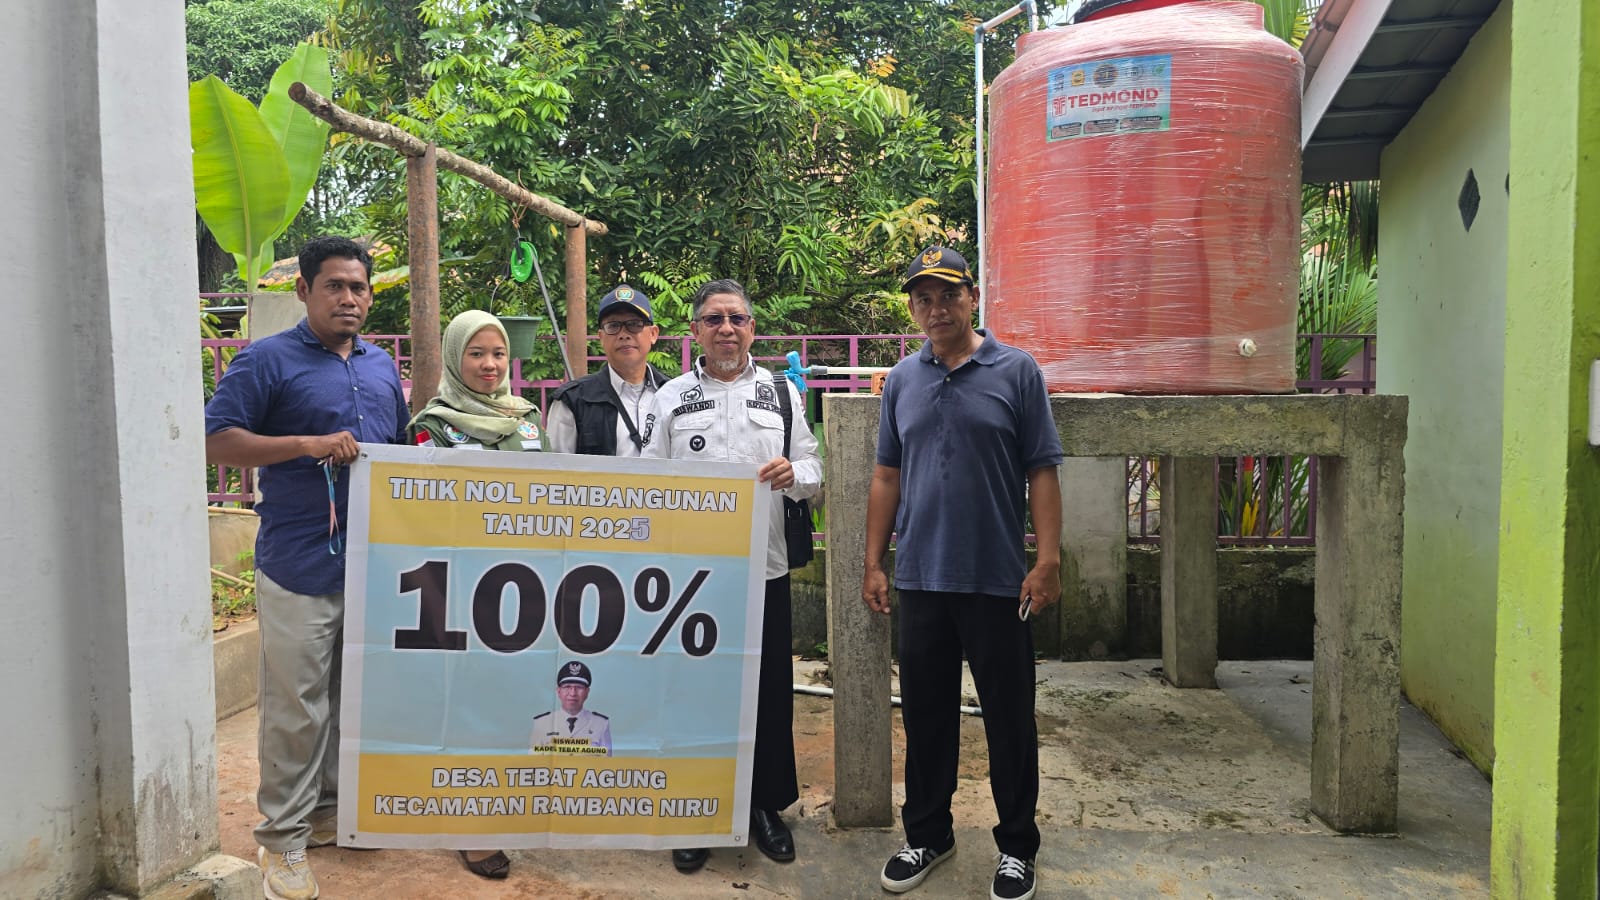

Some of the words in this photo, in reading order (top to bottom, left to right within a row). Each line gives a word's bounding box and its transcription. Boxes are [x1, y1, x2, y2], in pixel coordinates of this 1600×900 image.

[1068, 88, 1159, 108] TEDMOND
[389, 477, 457, 501] TITIK
[465, 480, 523, 504] NOL
[529, 483, 737, 512] PEMBANGUNAN
[483, 513, 573, 537] TAHUN
[580, 517, 650, 541] 2025
[393, 559, 718, 657] 100%
[432, 768, 499, 788] DESA
[505, 768, 578, 787] TEBAT
[582, 769, 666, 790] AGUNG
[375, 795, 525, 816] KECAMATAN
[532, 797, 653, 817] RAMBANG
[660, 798, 718, 818] NIRU
